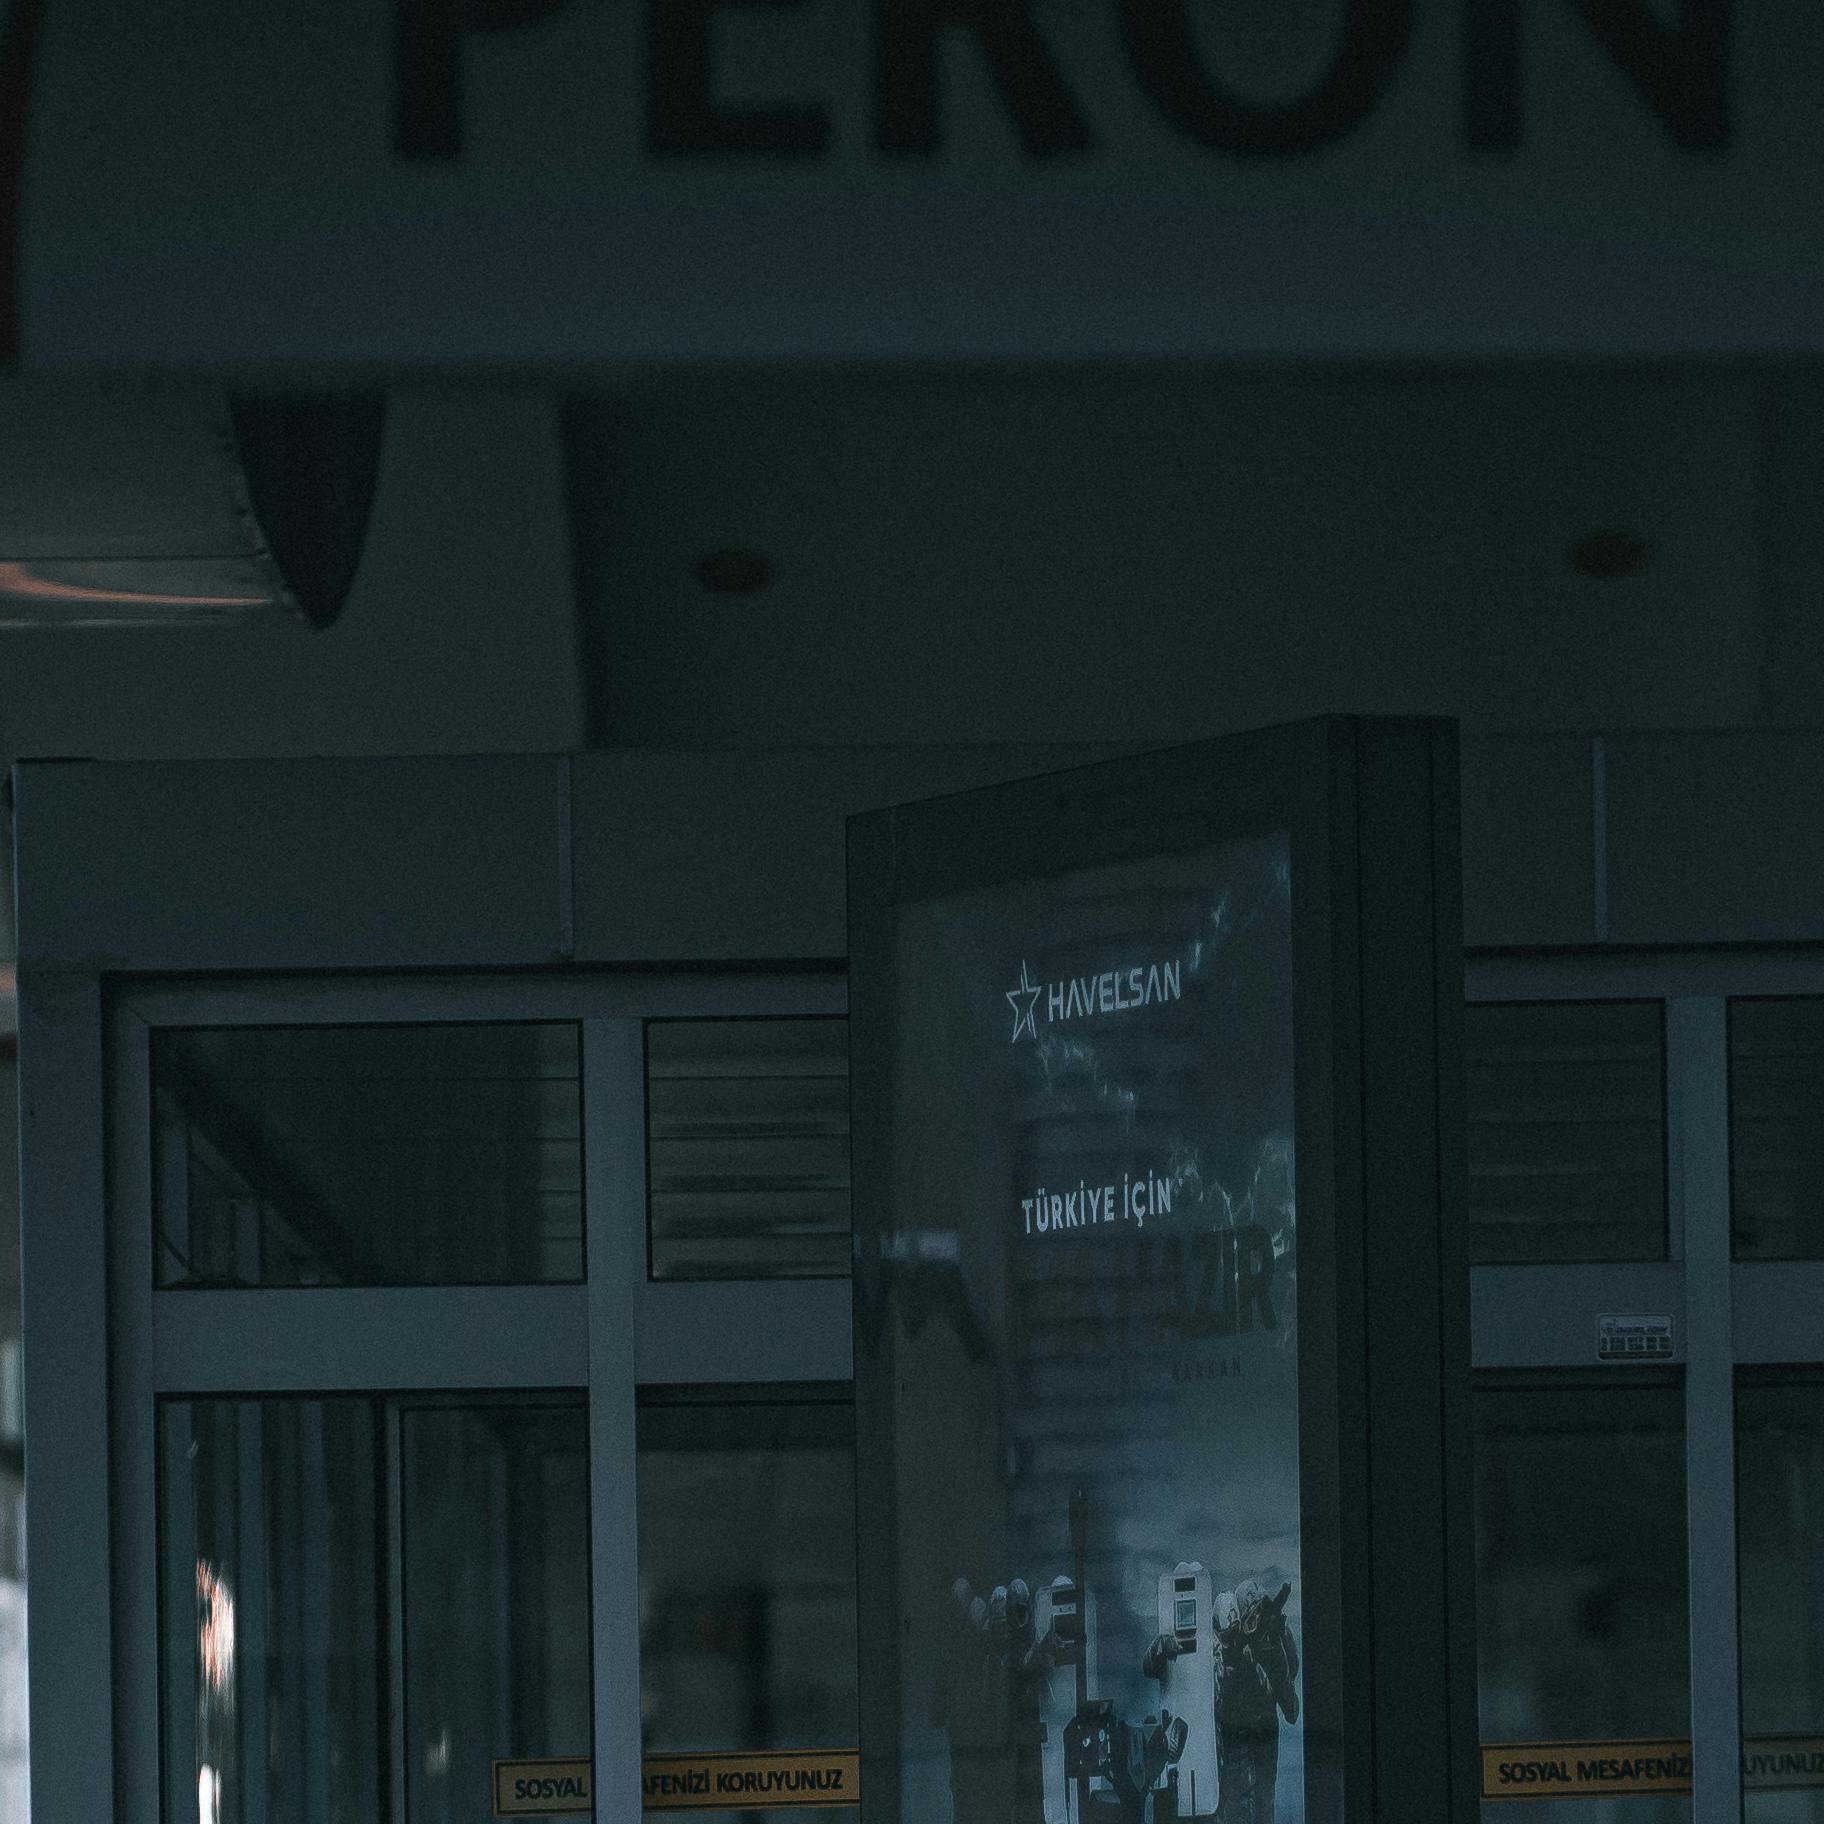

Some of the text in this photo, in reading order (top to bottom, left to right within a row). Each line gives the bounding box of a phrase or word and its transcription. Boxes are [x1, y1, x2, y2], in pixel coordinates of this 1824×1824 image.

[1048, 960, 1181, 1022] HAVELSAN
[1021, 1168, 1172, 1234] TÜRKİYE İÇİN
[515, 1778, 588, 1800] SOSYAL
[716, 1768, 843, 1794] KORUYUNUZ
[1499, 1757, 1572, 1784] SOSYAL
